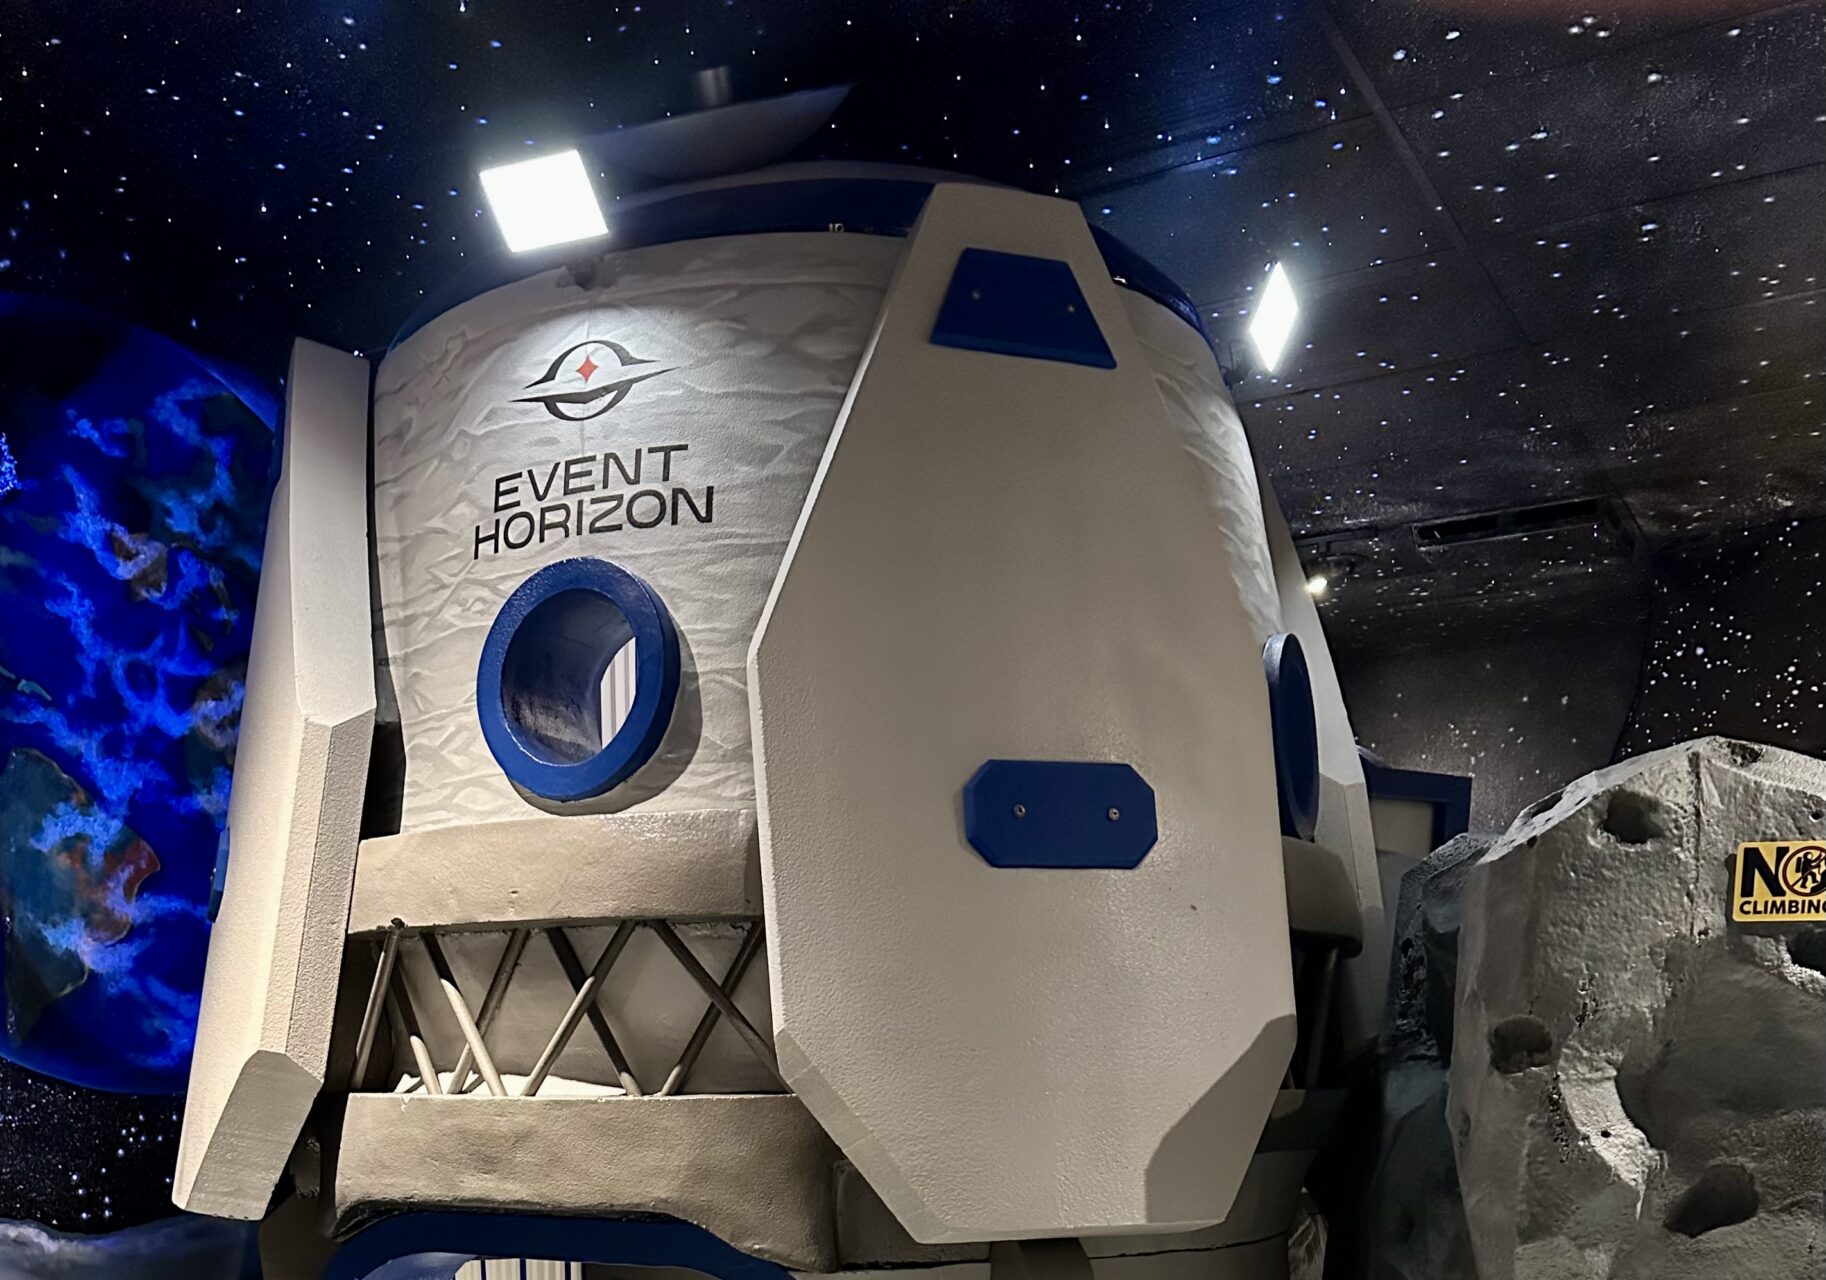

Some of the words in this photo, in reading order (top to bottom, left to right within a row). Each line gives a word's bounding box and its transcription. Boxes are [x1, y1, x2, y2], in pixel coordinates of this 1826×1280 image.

[494, 444, 689, 513] EVENT
[473, 485, 714, 560] HORIZON
[1740, 899, 1826, 915] CLIMBIN
